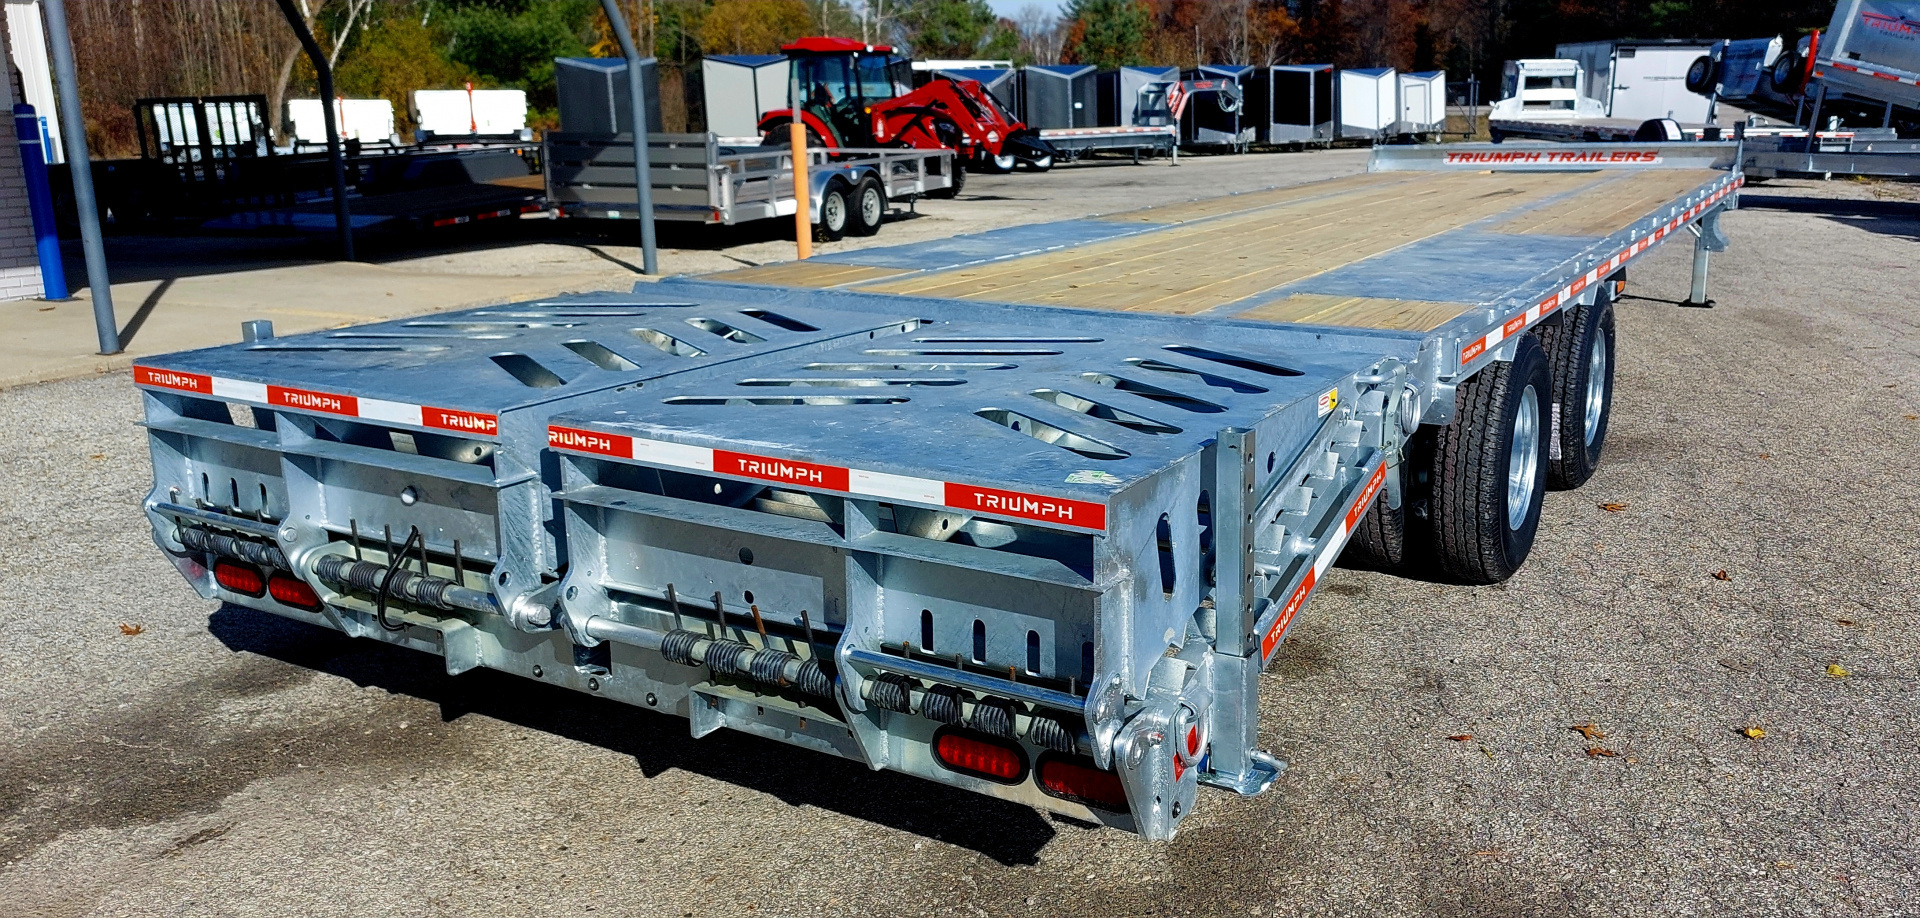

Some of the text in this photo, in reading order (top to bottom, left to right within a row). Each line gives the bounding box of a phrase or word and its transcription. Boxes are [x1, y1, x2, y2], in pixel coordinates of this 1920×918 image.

[1447, 151, 1660, 163] TRIUMPH TRAILERS
[1462, 343, 1482, 361] TRIUMPH
[147, 371, 198, 389] TRIUMPH
[283, 392, 341, 410] TRIUMPH
[440, 414, 497, 430] TRIUMP
[548, 431, 611, 450] RIUMPH
[738, 459, 822, 483] TRIUMPH
[1353, 471, 1383, 517] TRIUMPH
[973, 492, 1073, 519] TRIUMPH
[1270, 585, 1306, 642] TRIUMPH
